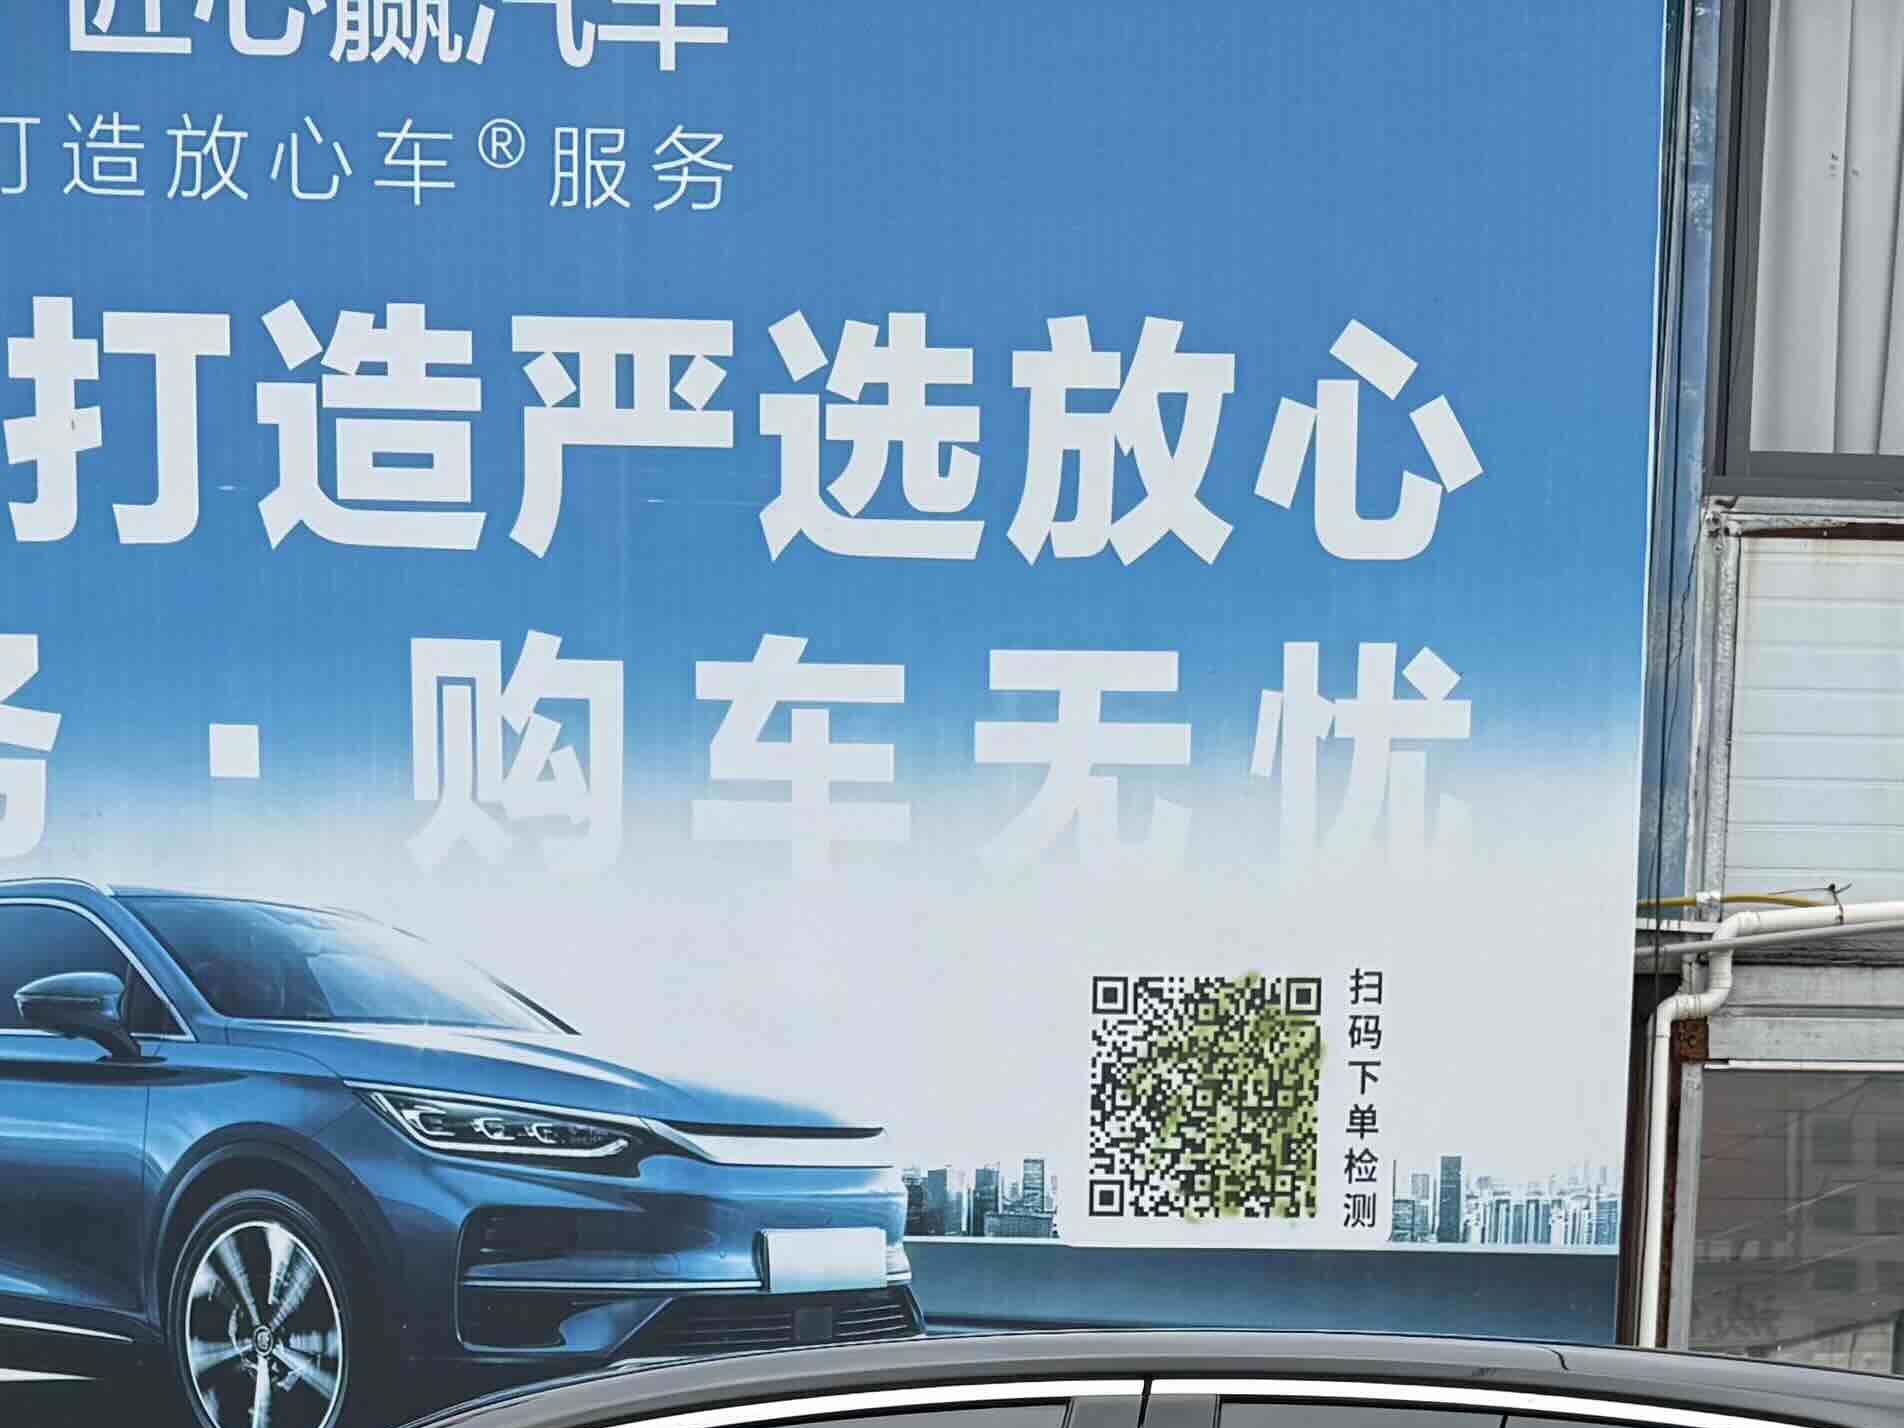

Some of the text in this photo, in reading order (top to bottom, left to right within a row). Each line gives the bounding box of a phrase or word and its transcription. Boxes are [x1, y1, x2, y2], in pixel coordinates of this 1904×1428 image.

[1343, 967, 1384, 1229] 扫码下单检测
